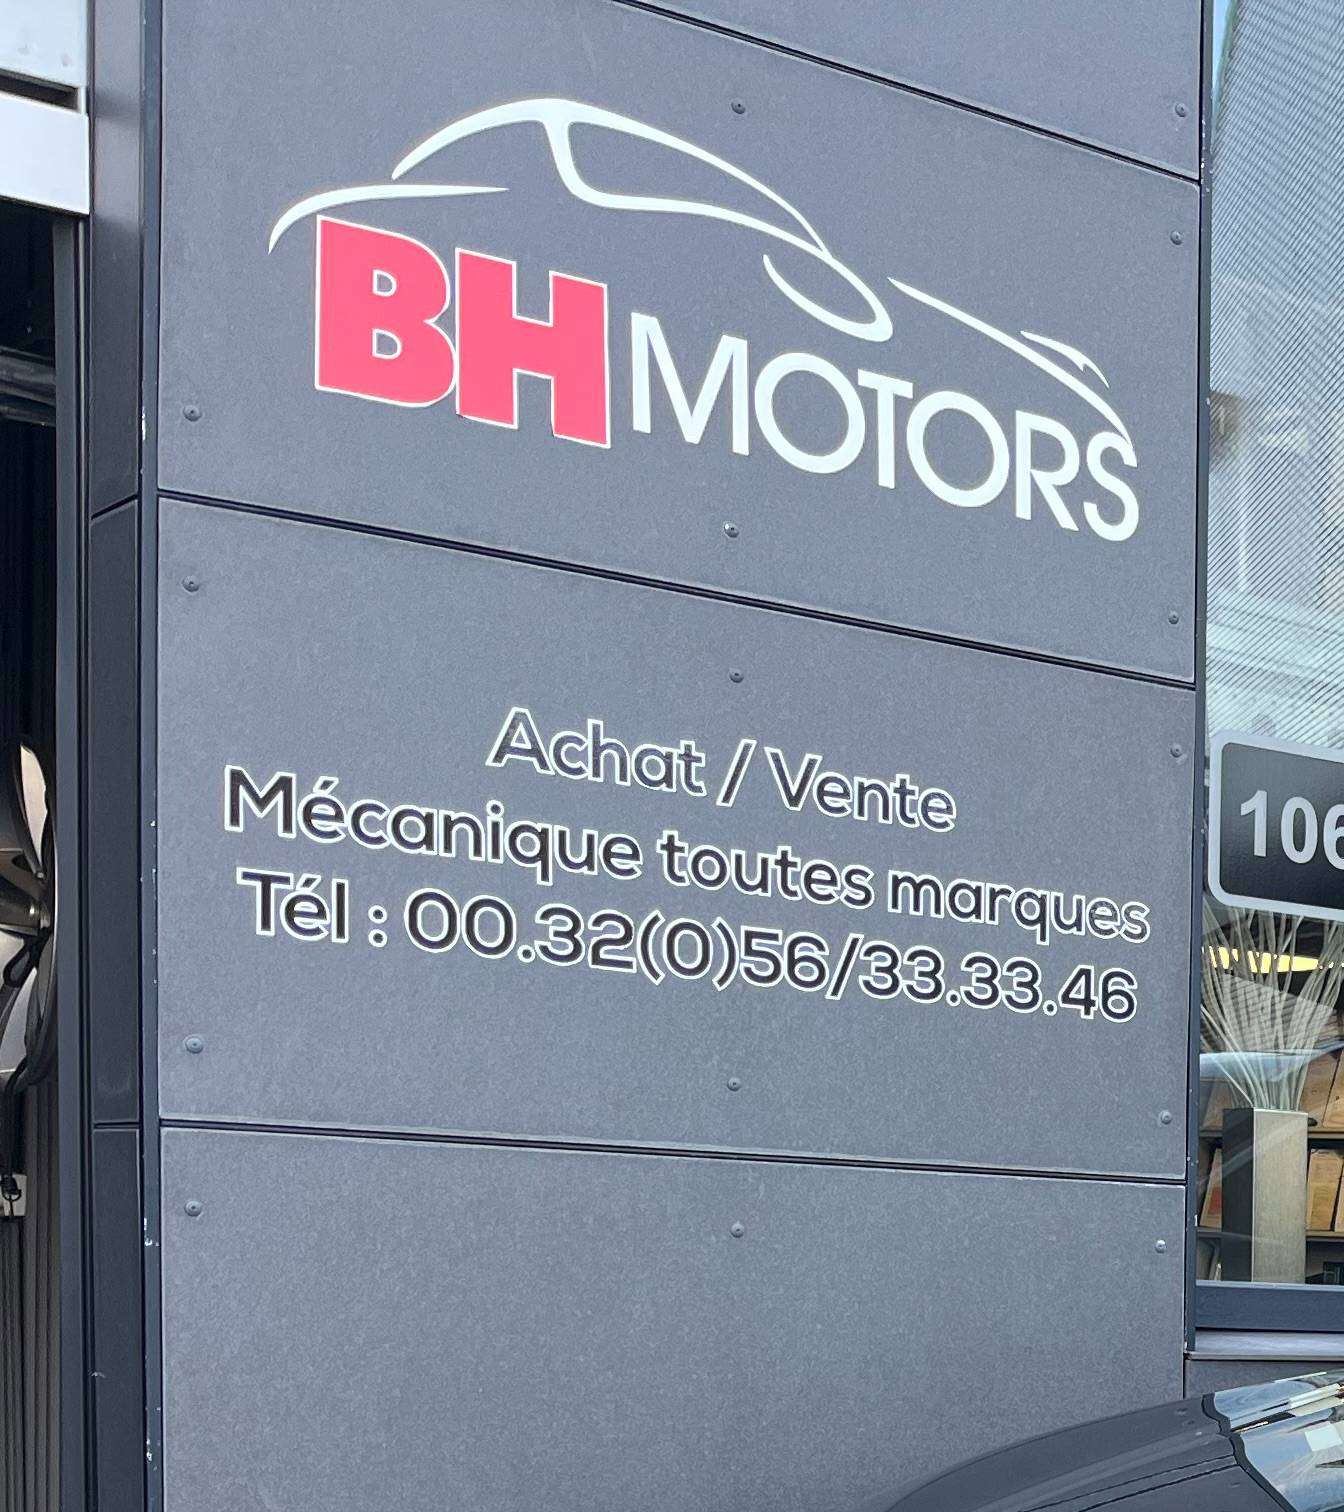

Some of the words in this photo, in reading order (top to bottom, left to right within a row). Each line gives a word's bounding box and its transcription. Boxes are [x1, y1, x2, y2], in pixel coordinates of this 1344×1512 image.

[315, 215, 611, 448] BH
[631, 311, 1140, 541] MOTORS
[485, 706, 707, 797] Achat
[716, 738, 757, 807] /
[765, 746, 957, 832] Vente
[223, 764, 643, 886] Mécanique
[656, 830, 875, 909] toutes
[887, 869, 1151, 946] marques
[236, 866, 349, 943] Tél
[403, 887, 1138, 1024] 00.32(0)56/33.33.46
